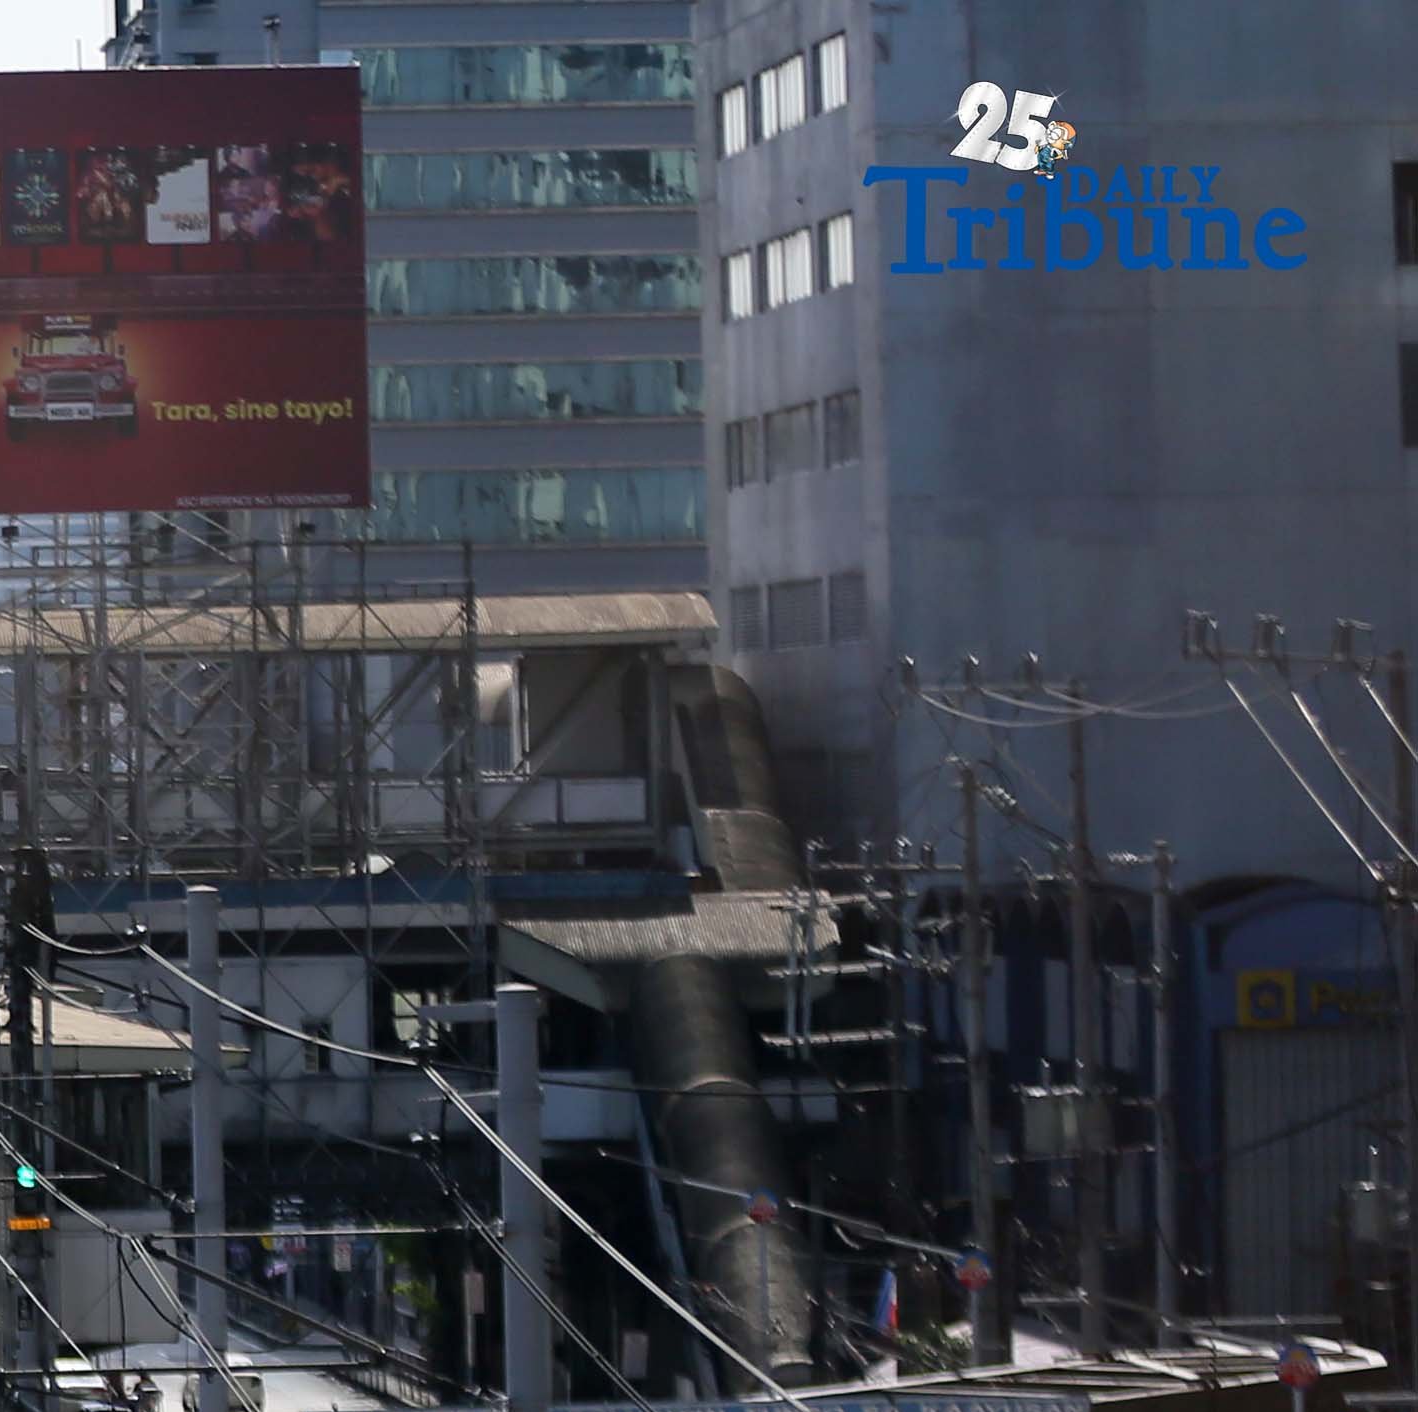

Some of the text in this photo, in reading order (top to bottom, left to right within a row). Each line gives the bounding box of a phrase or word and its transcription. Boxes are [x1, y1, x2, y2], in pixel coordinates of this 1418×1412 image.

[151, 398, 354, 425] Tara, sine tayo!
